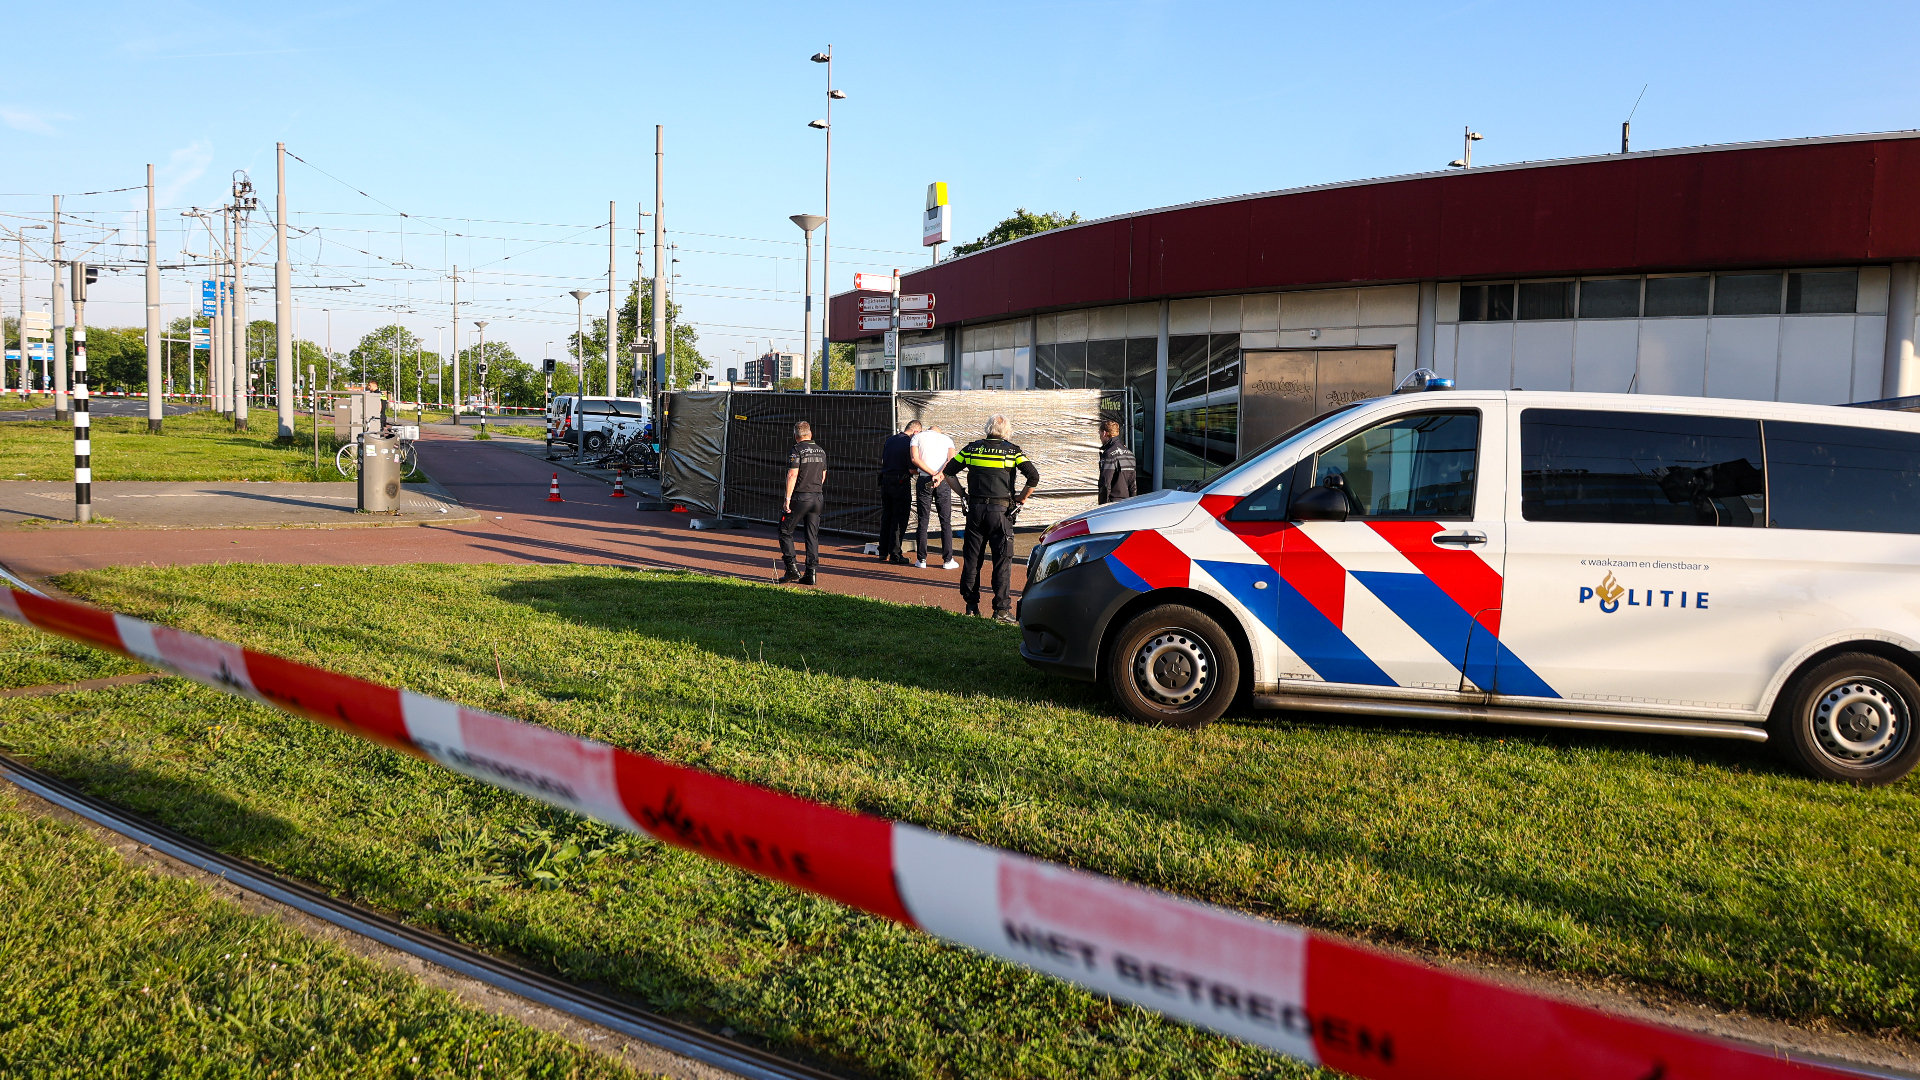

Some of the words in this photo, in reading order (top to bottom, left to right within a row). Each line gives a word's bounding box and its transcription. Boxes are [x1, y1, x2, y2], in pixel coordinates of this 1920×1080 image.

[1588, 558, 1638, 568] waakzaam
[1638, 560, 1651, 569] en
[1652, 560, 1702, 571] dienstbaar
[1579, 586, 1710, 614] POLITIE
[1003, 916, 1101, 971] NIET
[1112, 950, 1397, 1064] BETREDEN
